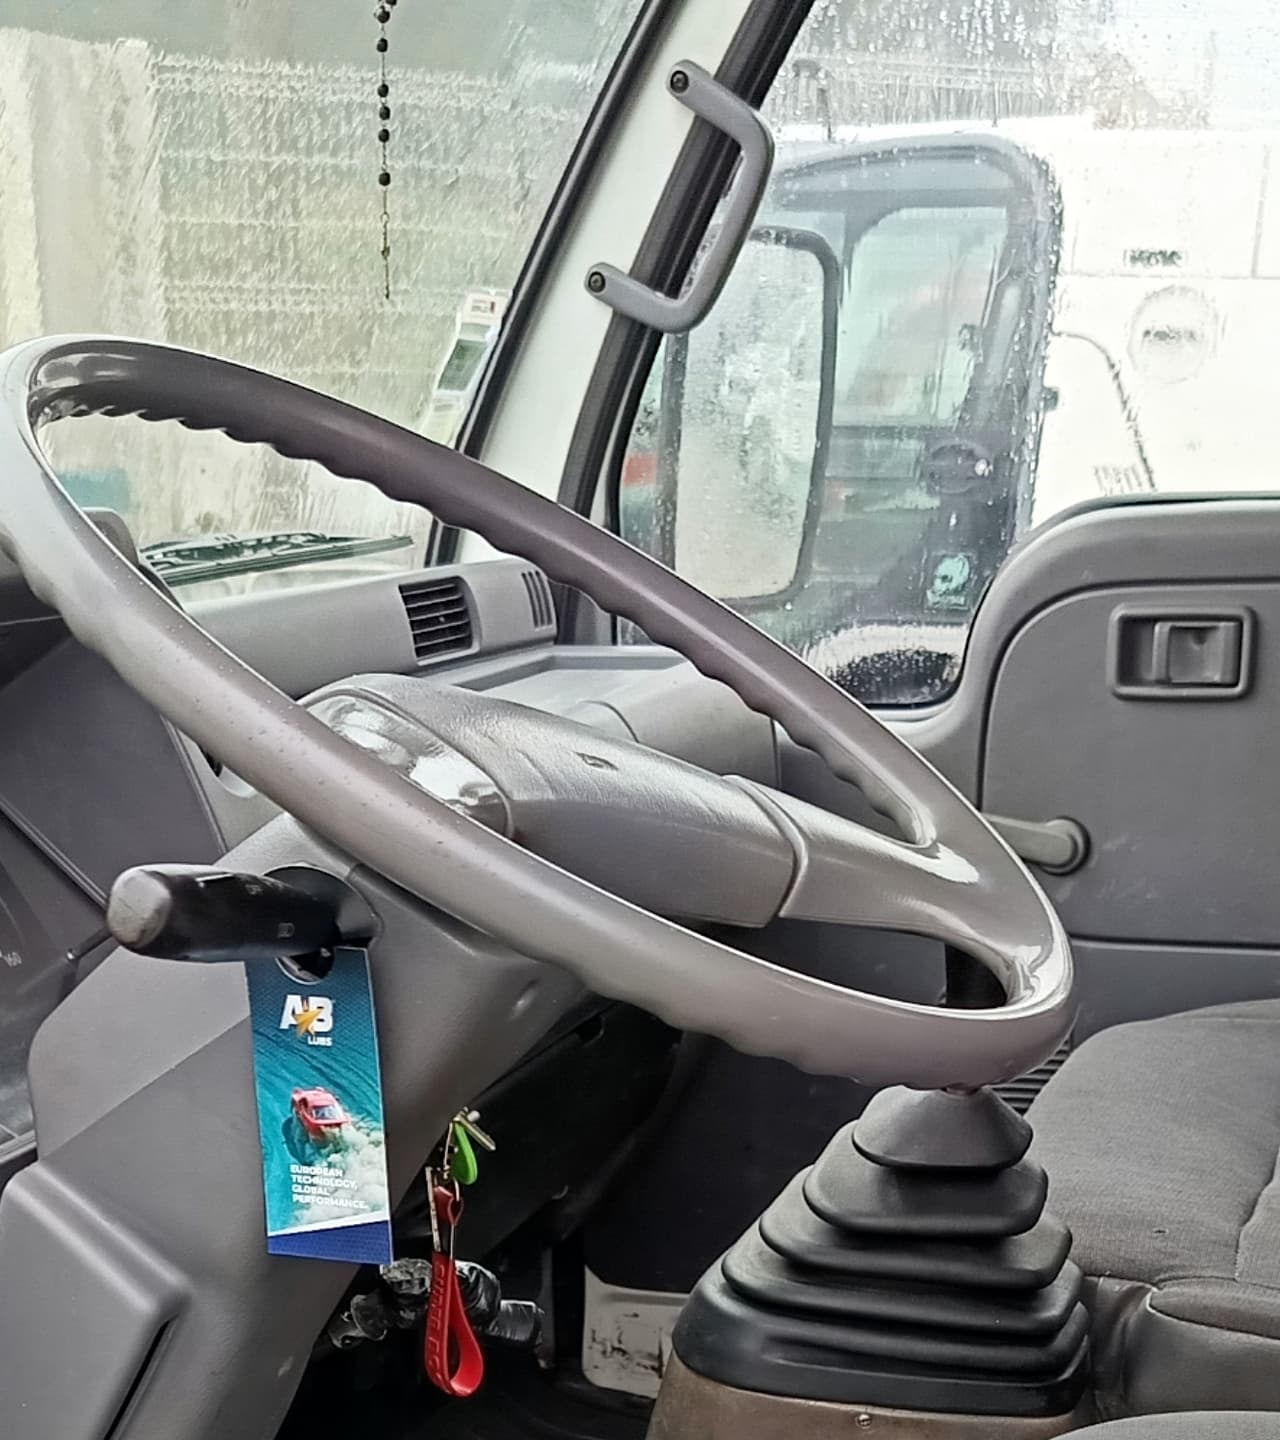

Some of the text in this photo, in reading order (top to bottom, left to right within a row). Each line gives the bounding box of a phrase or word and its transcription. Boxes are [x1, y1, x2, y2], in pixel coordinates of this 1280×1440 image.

[307, 1035, 333, 1047] LUBS
[289, 1164, 343, 1177] EUROPEAN
[290, 1174, 359, 1191] TECHNOLOGY,
[291, 1184, 331, 1196] GLOBAL
